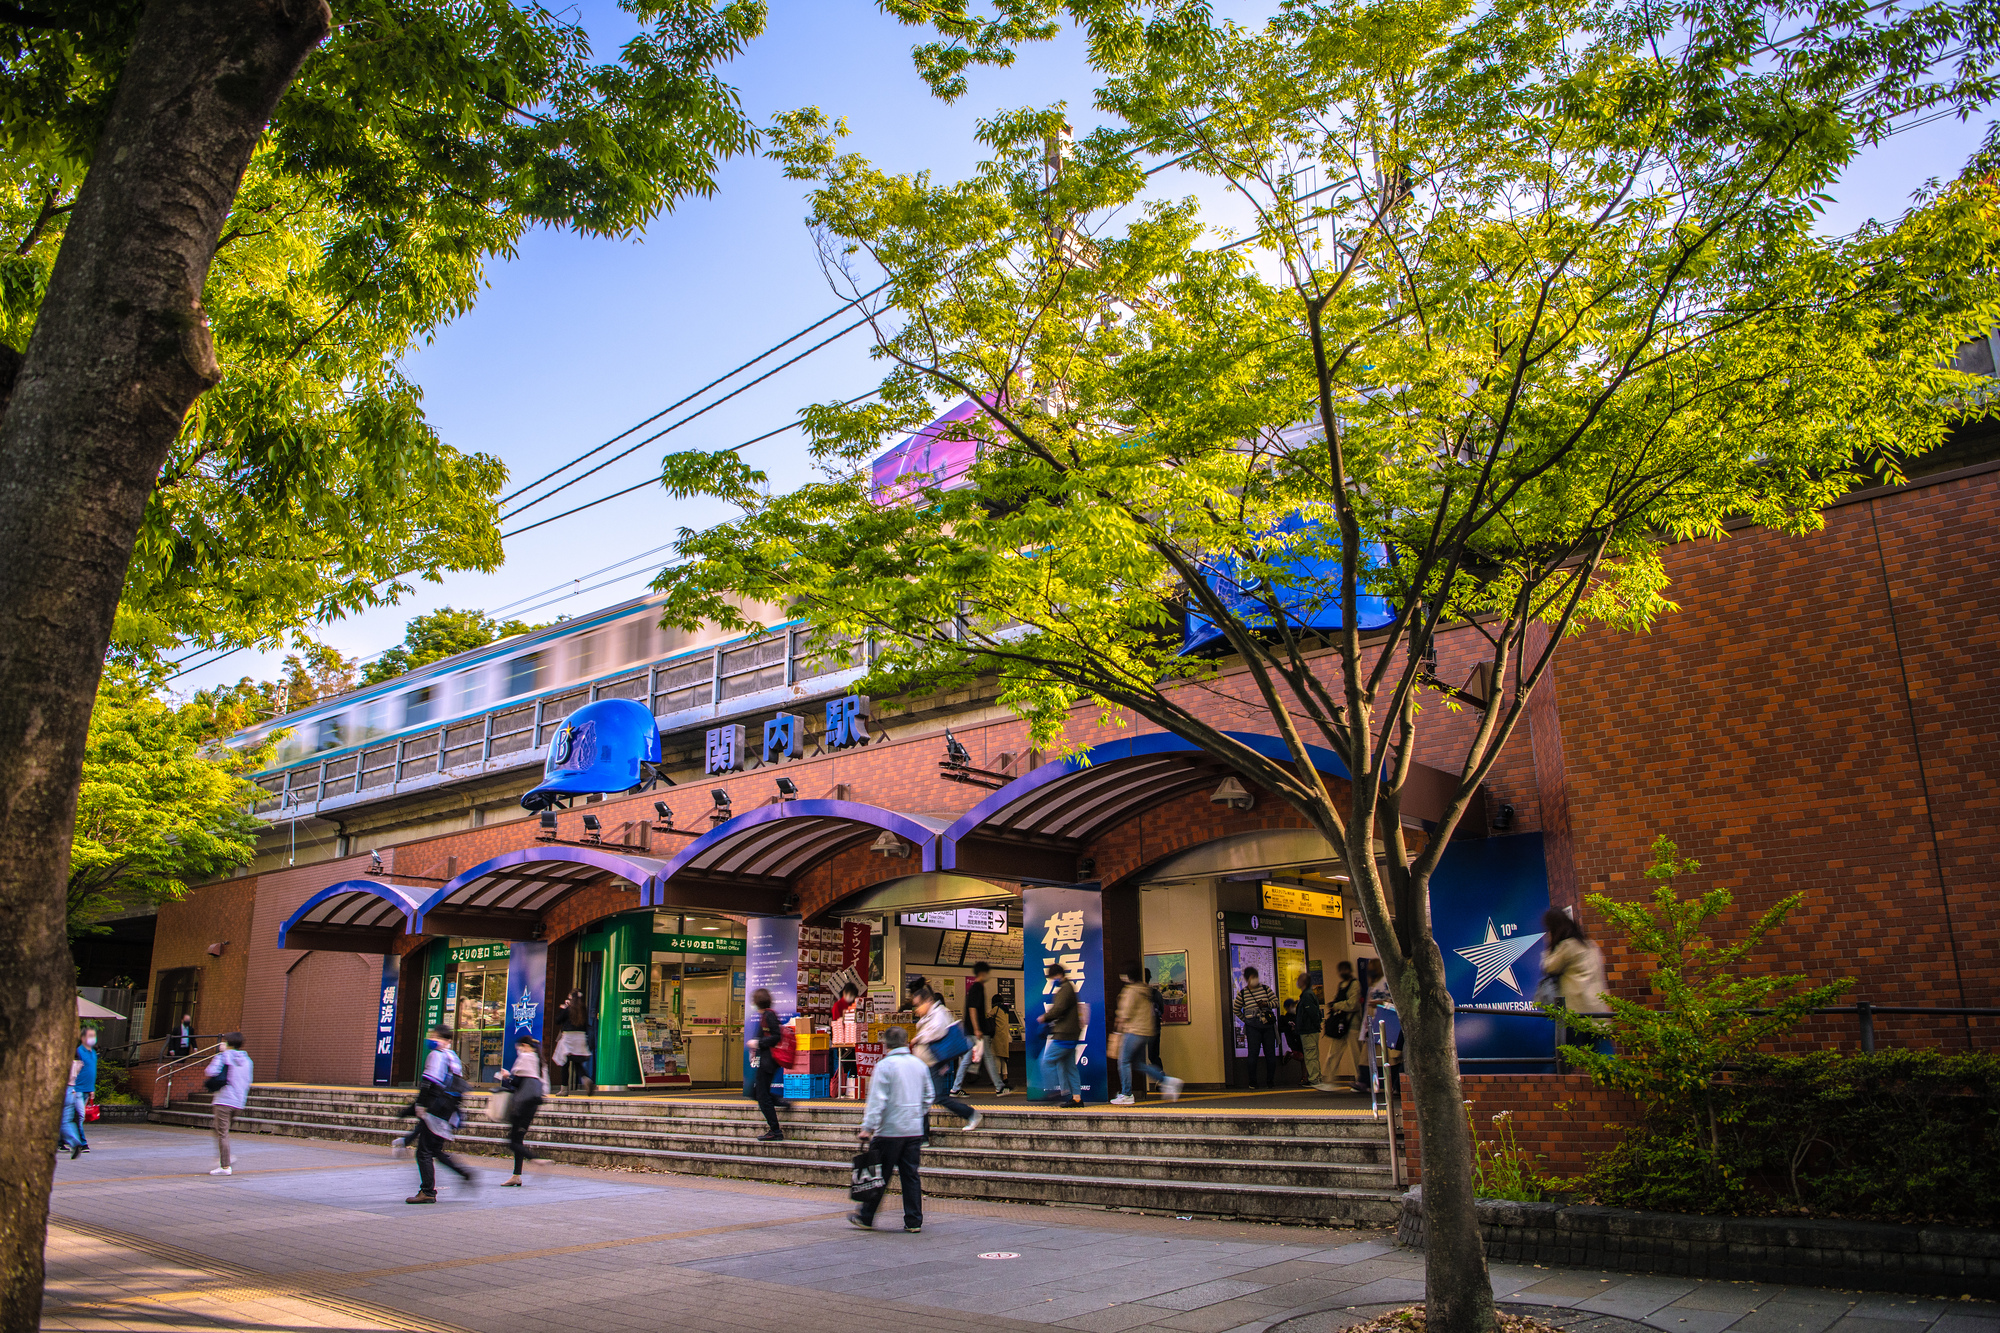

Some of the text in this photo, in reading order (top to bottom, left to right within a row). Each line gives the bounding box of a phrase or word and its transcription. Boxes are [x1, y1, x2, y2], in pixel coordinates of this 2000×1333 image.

[705, 695, 868, 775] 関内駅
[1500, 923, 1517, 937] 10th
[671, 938, 714, 950] みどりの窓口
[851, 926, 863, 966] シウマイ
[452, 947, 490, 961] みどりの窓口
